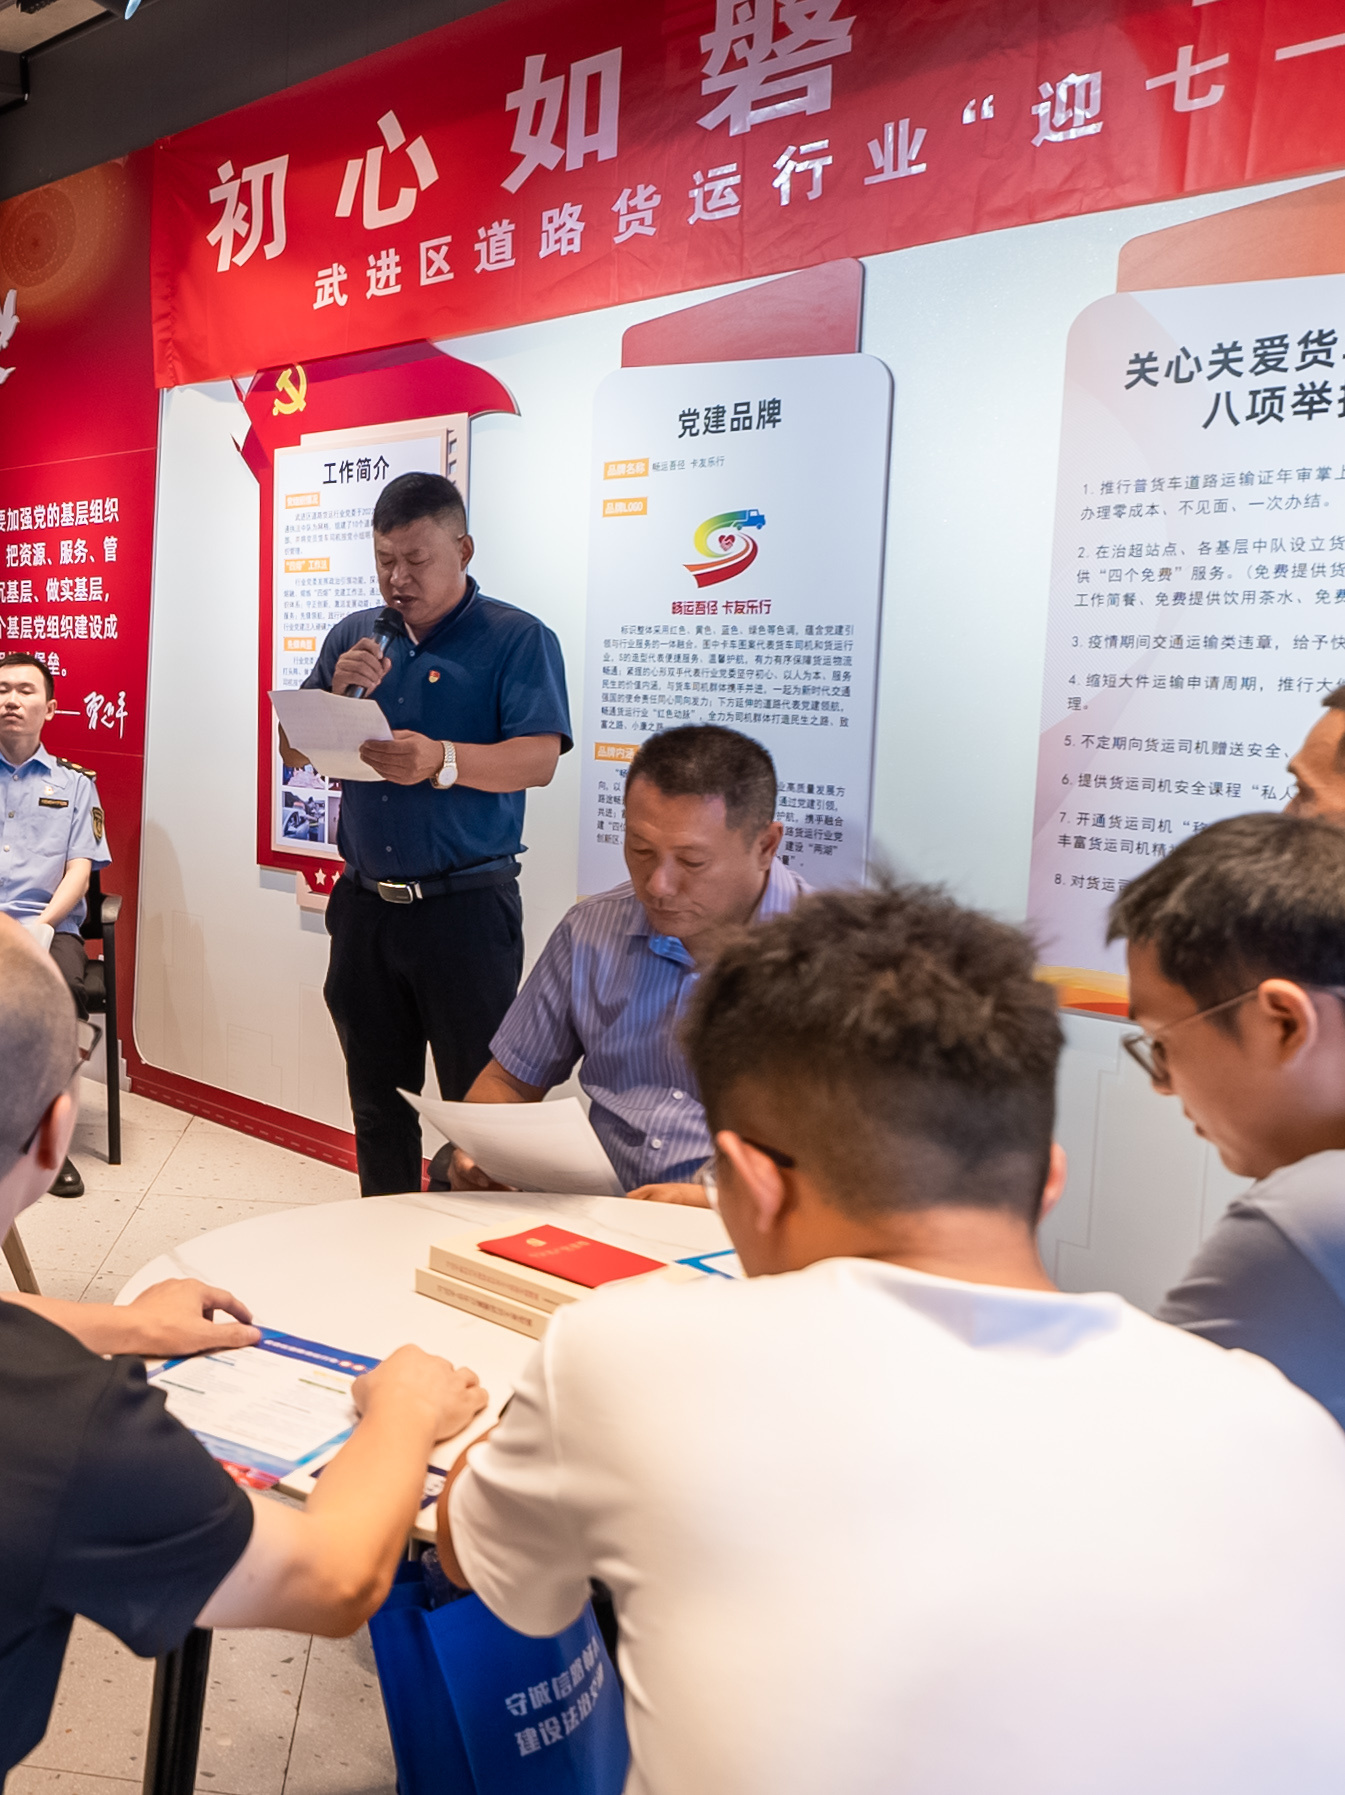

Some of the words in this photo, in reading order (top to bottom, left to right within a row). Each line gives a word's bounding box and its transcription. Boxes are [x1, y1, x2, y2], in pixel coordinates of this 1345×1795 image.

[1124, 328, 1345, 390] 关心关爱货
[678, 398, 782, 438] 党建品牌
[322, 455, 390, 485] 工作简介
[690, 456, 725, 469] 卡友乐行
[671, 601, 718, 615] 畅运吾径
[722, 599, 771, 615] 卡友乐行
